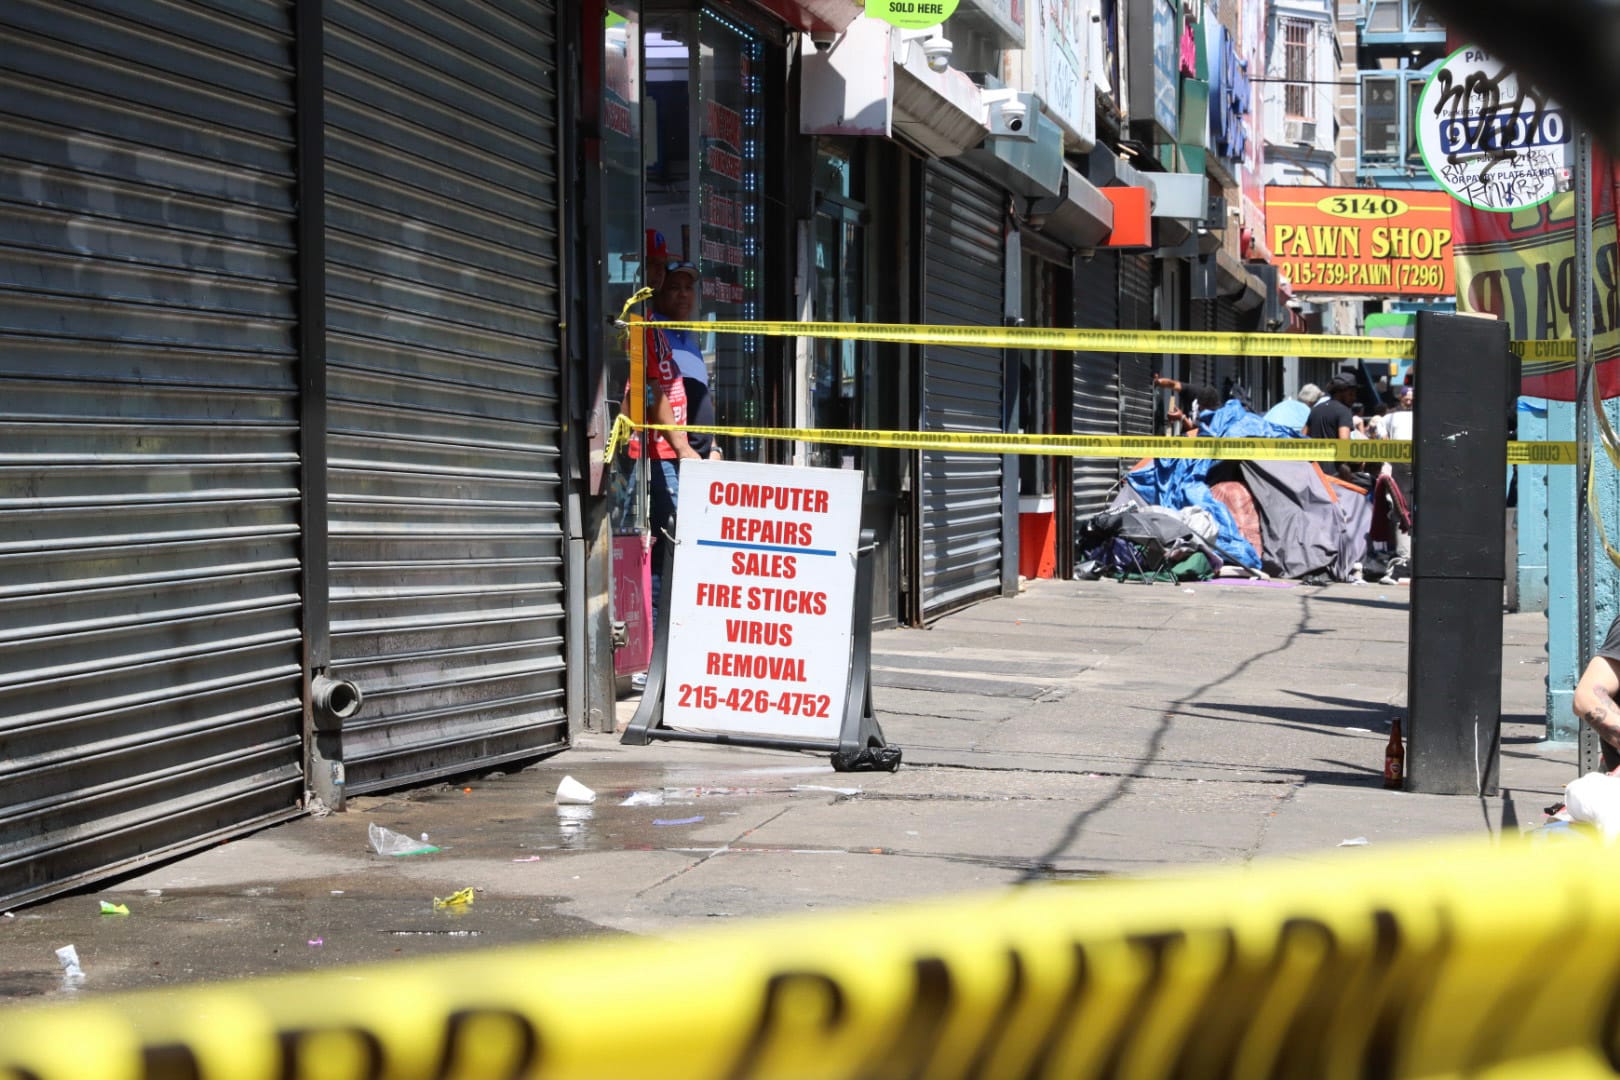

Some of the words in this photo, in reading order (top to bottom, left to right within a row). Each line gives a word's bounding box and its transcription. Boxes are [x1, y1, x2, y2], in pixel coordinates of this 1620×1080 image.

[889, 2, 914, 13] SOLD
[918, 3, 943, 14] HERE
[1331, 196, 1398, 215] 3140
[1274, 224, 1360, 258] PAWN
[1371, 226, 1452, 260] SHOP
[1283, 262, 1393, 286] 215-739-PAWN
[1395, 263, 1445, 290] (7296)
[709, 481, 829, 513] COMPUTER
[720, 516, 812, 546] REPAIRS
[732, 551, 797, 579] SALES
[696, 582, 742, 609] FIRE
[747, 586, 827, 616] STICKS
[726, 619, 793, 647] VIRUS
[706, 652, 807, 682] REMOVAL
[678, 684, 830, 718] 215-426-4752
